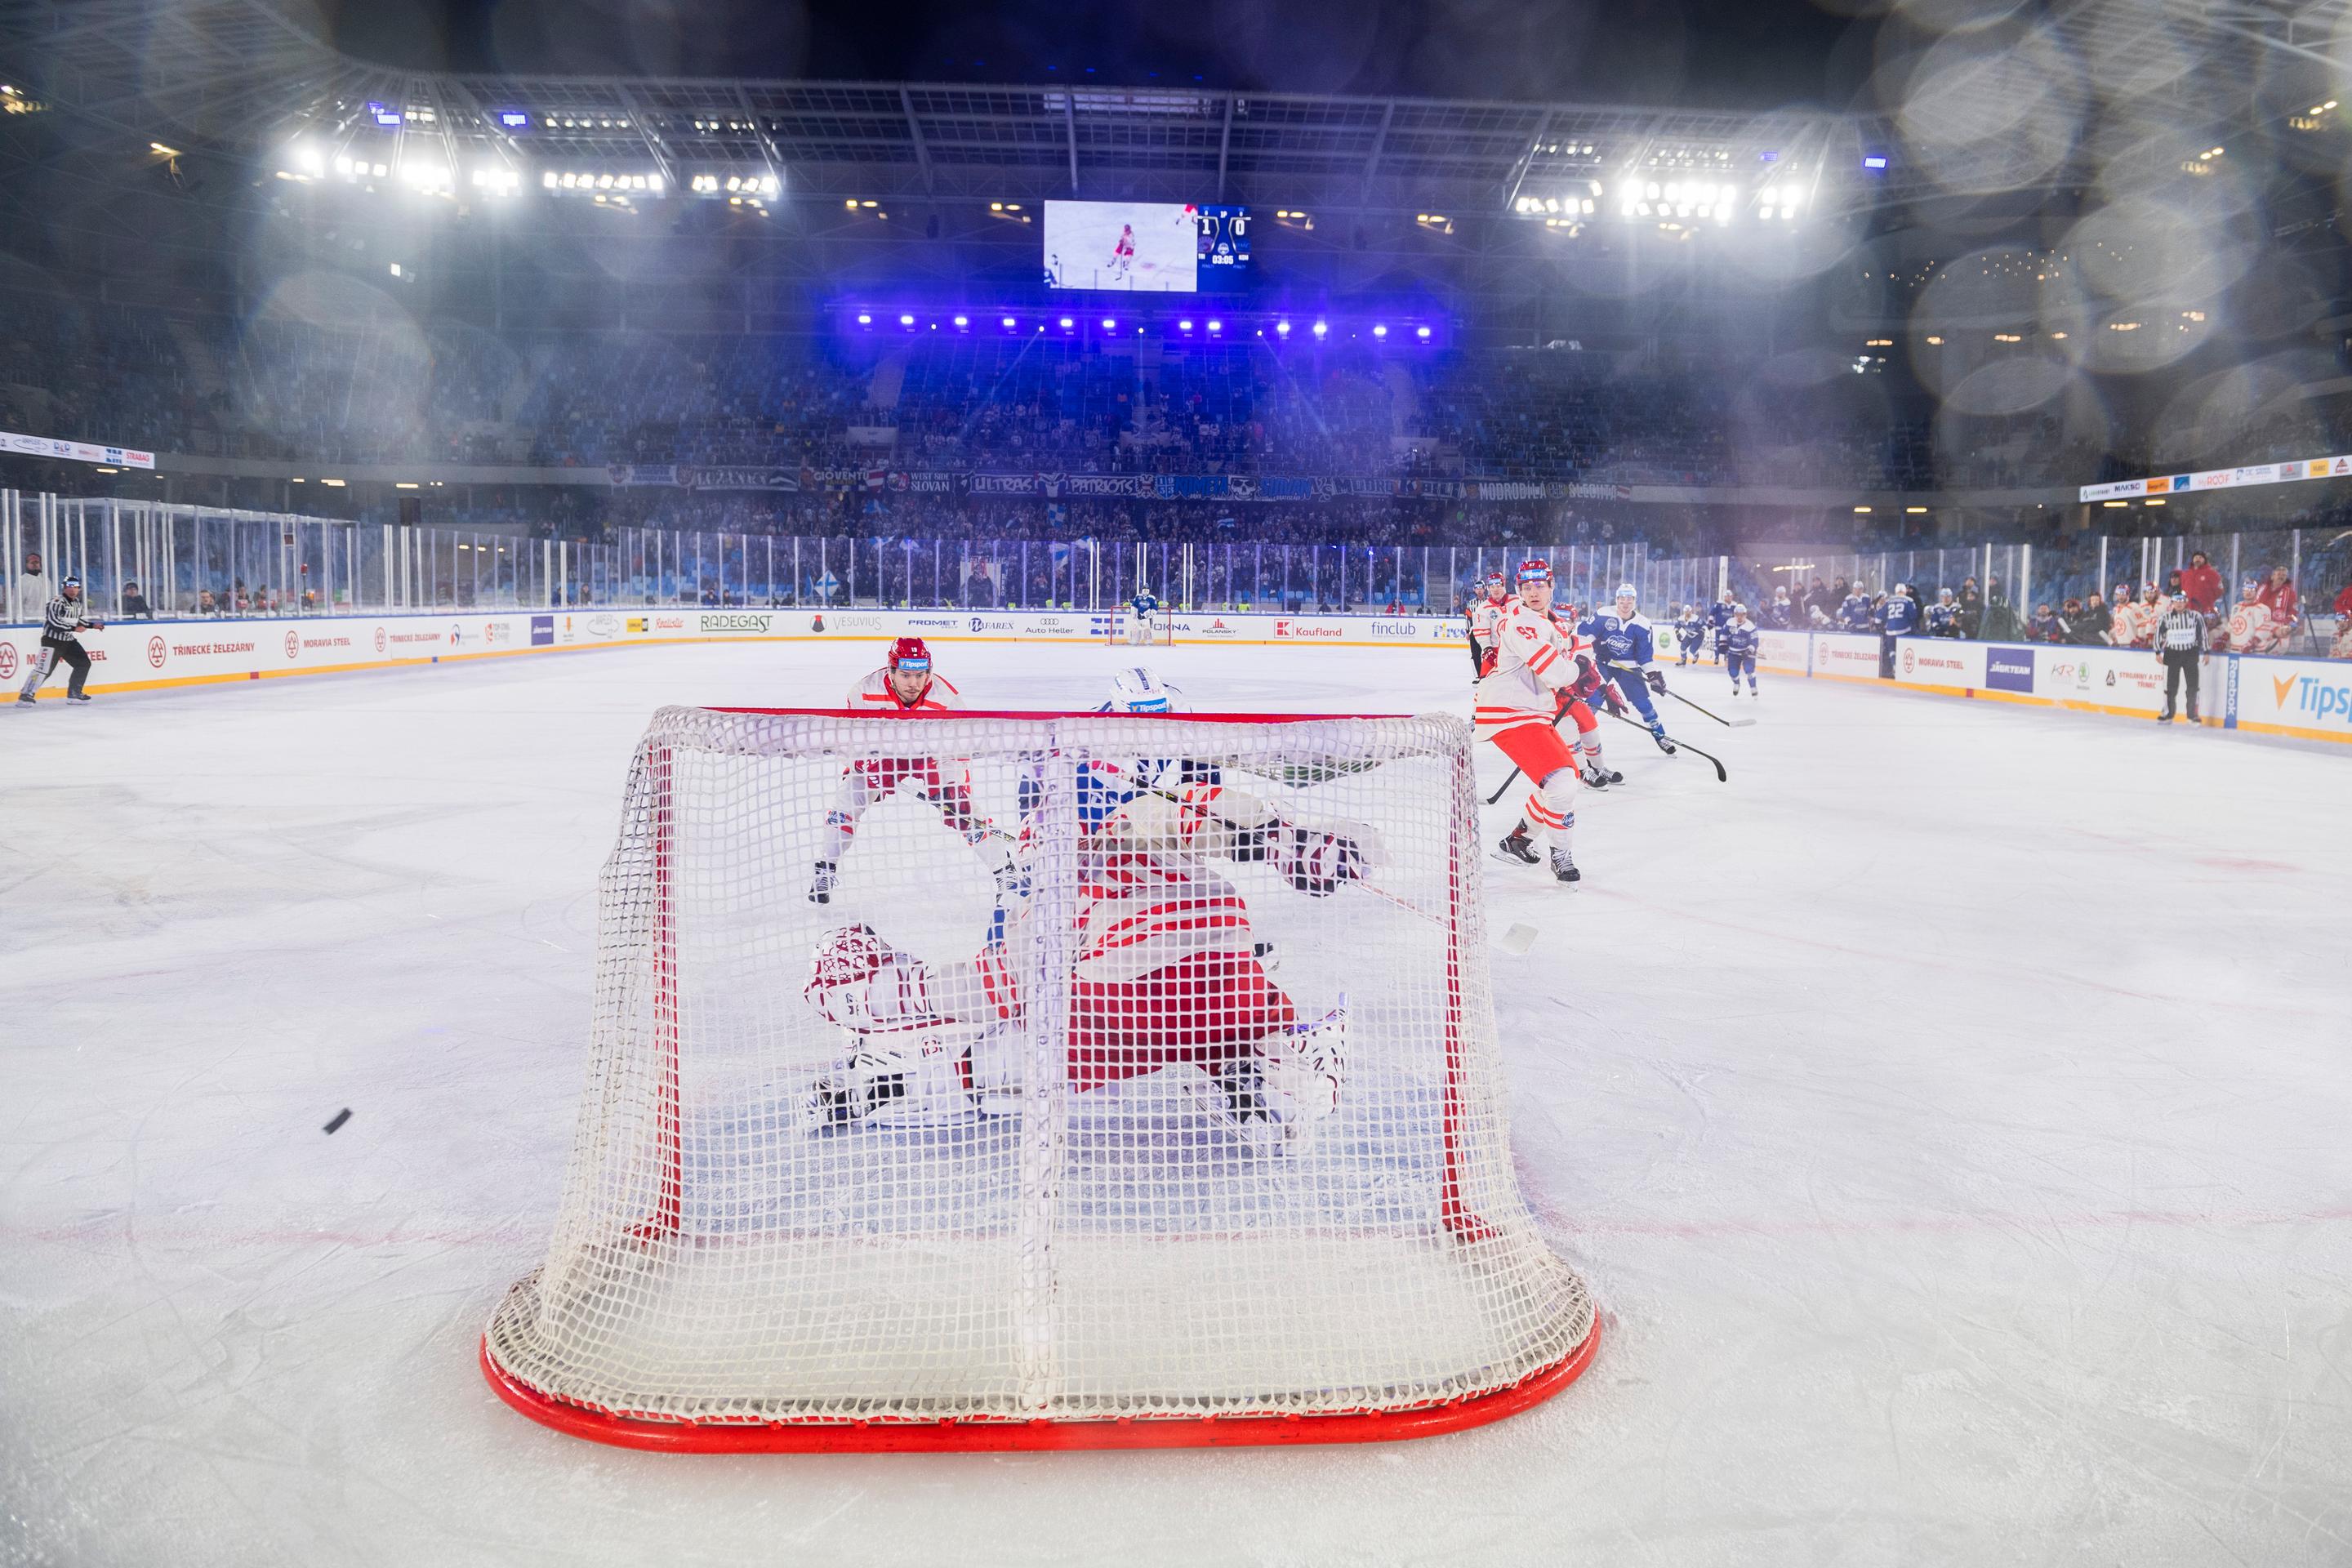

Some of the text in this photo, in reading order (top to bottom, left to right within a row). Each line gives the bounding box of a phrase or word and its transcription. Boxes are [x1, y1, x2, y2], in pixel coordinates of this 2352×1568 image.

[1202, 218, 1210, 234] 1
[1235, 220, 1245, 235] 0
[126, 452, 149, 462] STRABAG
[911, 481, 950, 492] SLOVAN
[975, 478, 1032, 491] ULTRAS
[1070, 478, 1133, 492] PATRIOTS
[1888, 603, 1904, 619] 22
[702, 615, 773, 633] RADEGAST
[833, 617, 882, 630] VESUVIUS
[969, 617, 1014, 632] WAFAREX
[1153, 623, 1191, 631] OKNA
[1371, 621, 1415, 635] finclub
[1296, 627, 1342, 637] Kaufland
[1516, 626, 1538, 640] 97
[173, 642, 255, 656] TŘINECKÉ ŽELEZÁRNY
[304, 637, 350, 648] MORAVIA STEEL
[84, 650, 107, 662] TEEL
[1918, 658, 1964, 670] MORAVIA STEEL
[2228, 659, 2238, 715] Reebok
